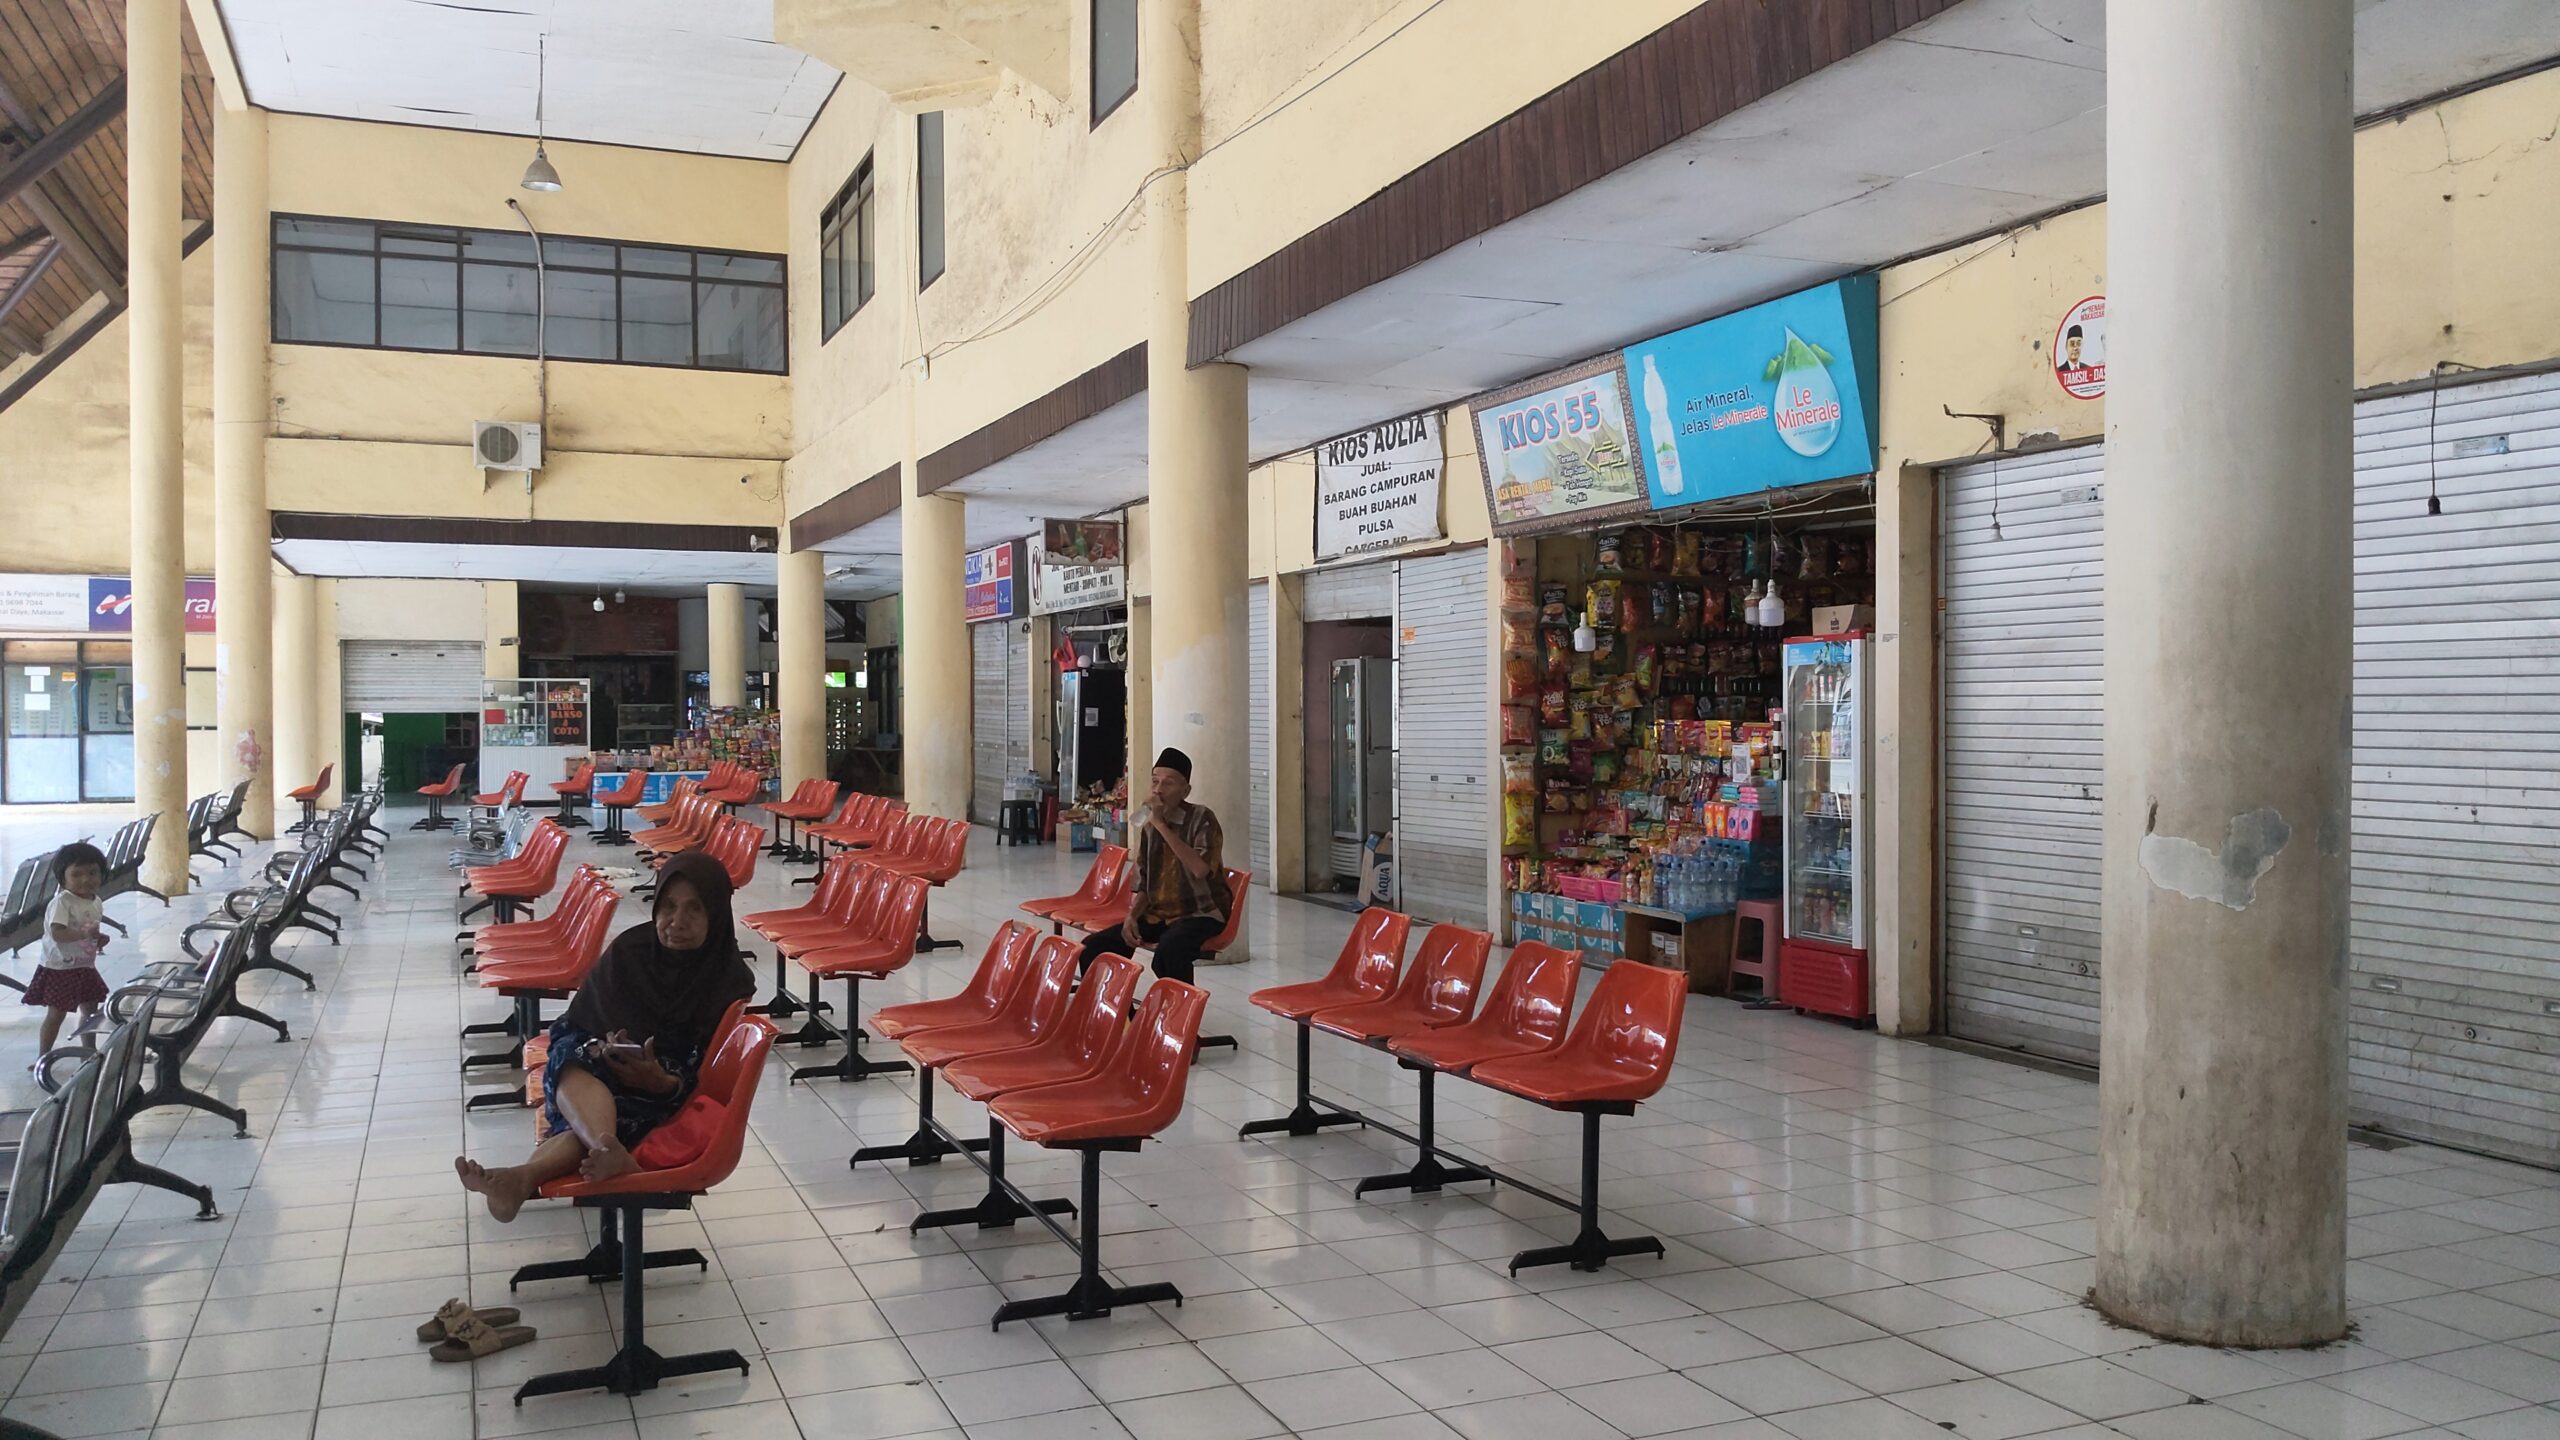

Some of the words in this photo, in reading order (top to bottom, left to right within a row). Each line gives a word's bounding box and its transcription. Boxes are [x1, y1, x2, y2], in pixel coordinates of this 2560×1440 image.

[2063, 369, 2089, 386] TAMSIL
[1686, 399, 1702, 414] Air
[1705, 384, 1754, 410] Mineral,
[1792, 386, 1812, 408] Le
[1498, 402, 1561, 452] KIOS
[1564, 390, 1601, 435] 55
[1681, 418, 1710, 436] Jelas
[1711, 413, 1724, 431] Le
[1776, 400, 1840, 431] Minerale
[1328, 432, 1369, 467] KIOS
[1373, 413, 1428, 455] AULIA
[1360, 460, 1392, 477] JUAL:
[1324, 485, 1367, 505] BARANG
[1370, 468, 1436, 494] CAMPURAN
[1339, 504, 1367, 521] BUAH
[1371, 493, 1417, 514] BUAHAN
[1358, 518, 1394, 536] PULSA
[56, 591, 80, 599] Barang
[31, 608, 65, 616] Makassar
[550, 709, 583, 719] BAKSO
[553, 726, 580, 736] COTO
[1379, 867, 1391, 896] AQUA
